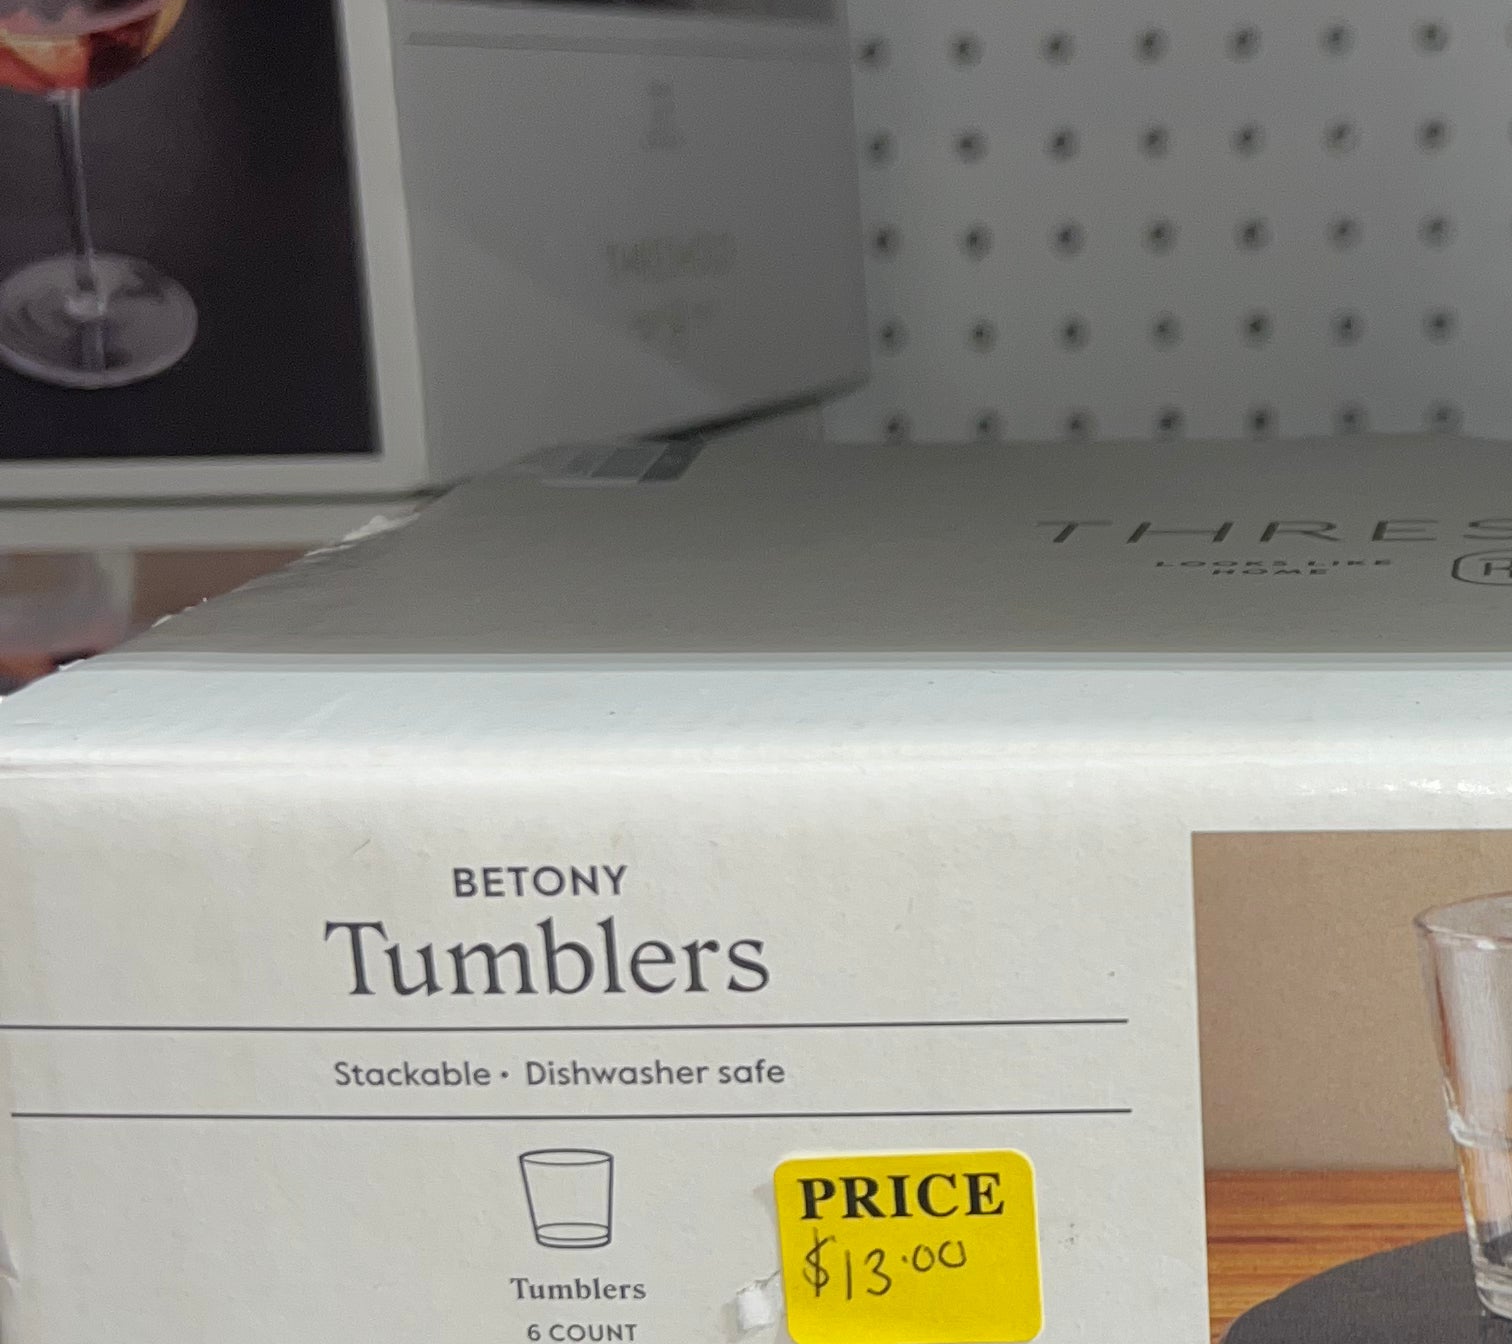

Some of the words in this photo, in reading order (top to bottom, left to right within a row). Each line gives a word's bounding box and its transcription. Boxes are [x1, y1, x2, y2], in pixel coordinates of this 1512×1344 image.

[453, 864, 628, 899] BETONY
[324, 916, 770, 998] Tumblers
[334, 1058, 491, 1087] Stackable
[525, 1058, 710, 1087] Dishwasher
[718, 1057, 785, 1085] safe
[797, 1172, 1005, 1220] PRICE
[510, 1277, 647, 1301] Tumblers
[527, 1323, 542, 1342] 6
[548, 1322, 638, 1342] COUNT
